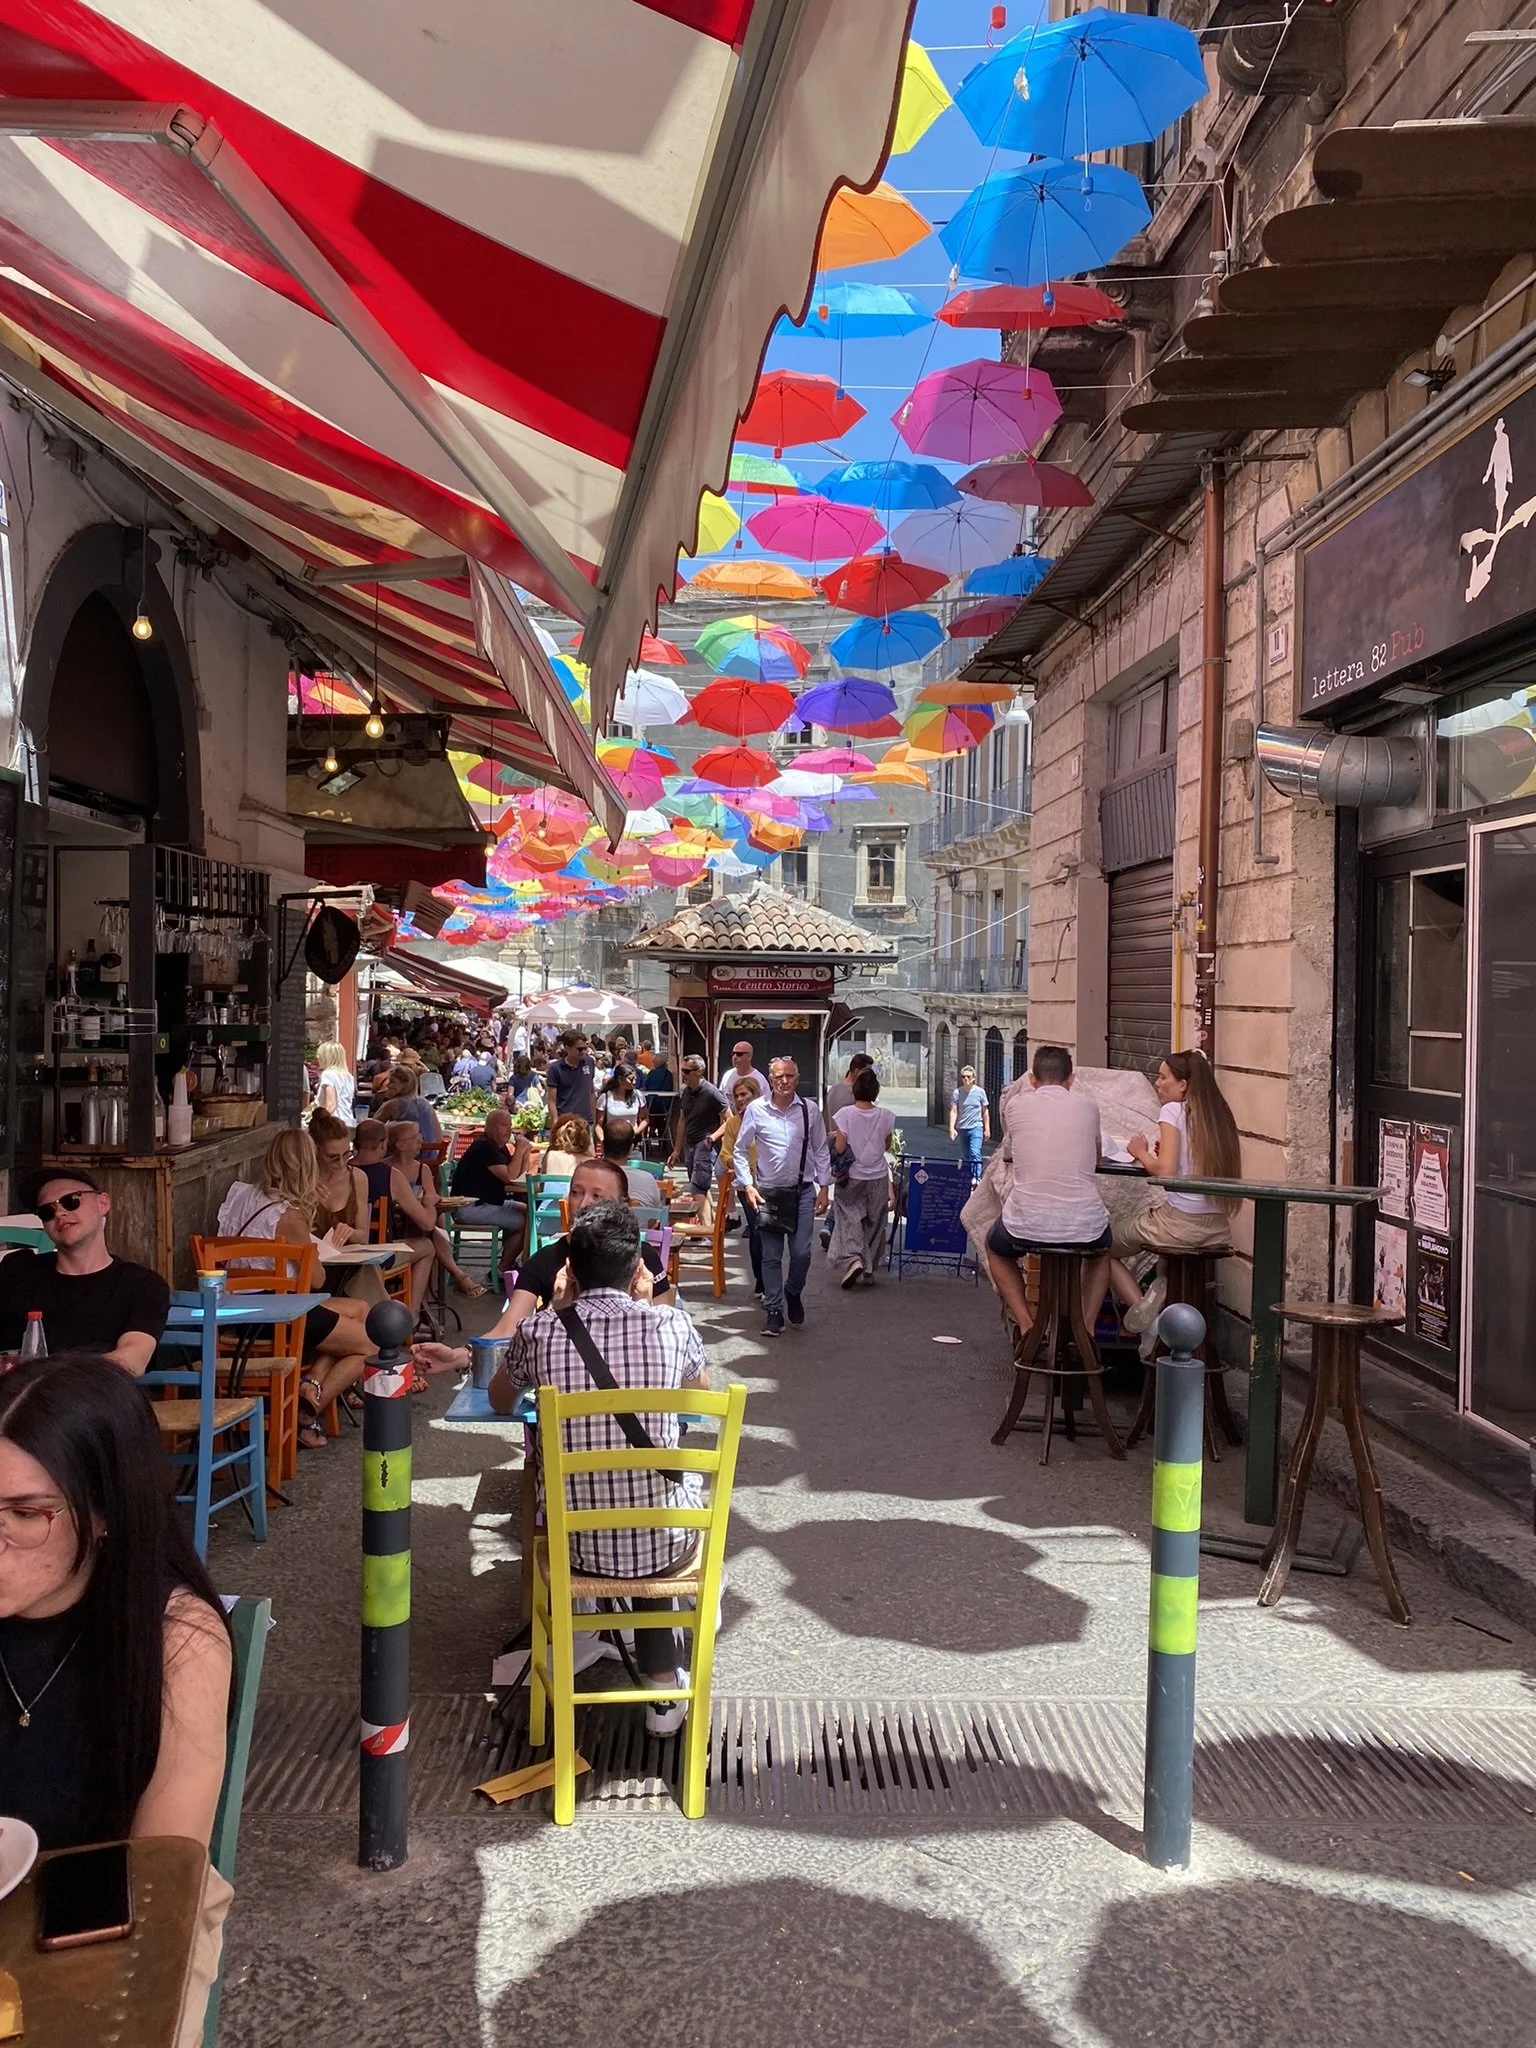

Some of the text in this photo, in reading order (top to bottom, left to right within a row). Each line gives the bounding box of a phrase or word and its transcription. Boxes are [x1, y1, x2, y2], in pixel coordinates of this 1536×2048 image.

[1312, 622, 1425, 699] lettera 82 Pub
[747, 968, 802, 978] CHIOSCO
[738, 981, 772, 990] Centro
[774, 981, 810, 991] Storico
